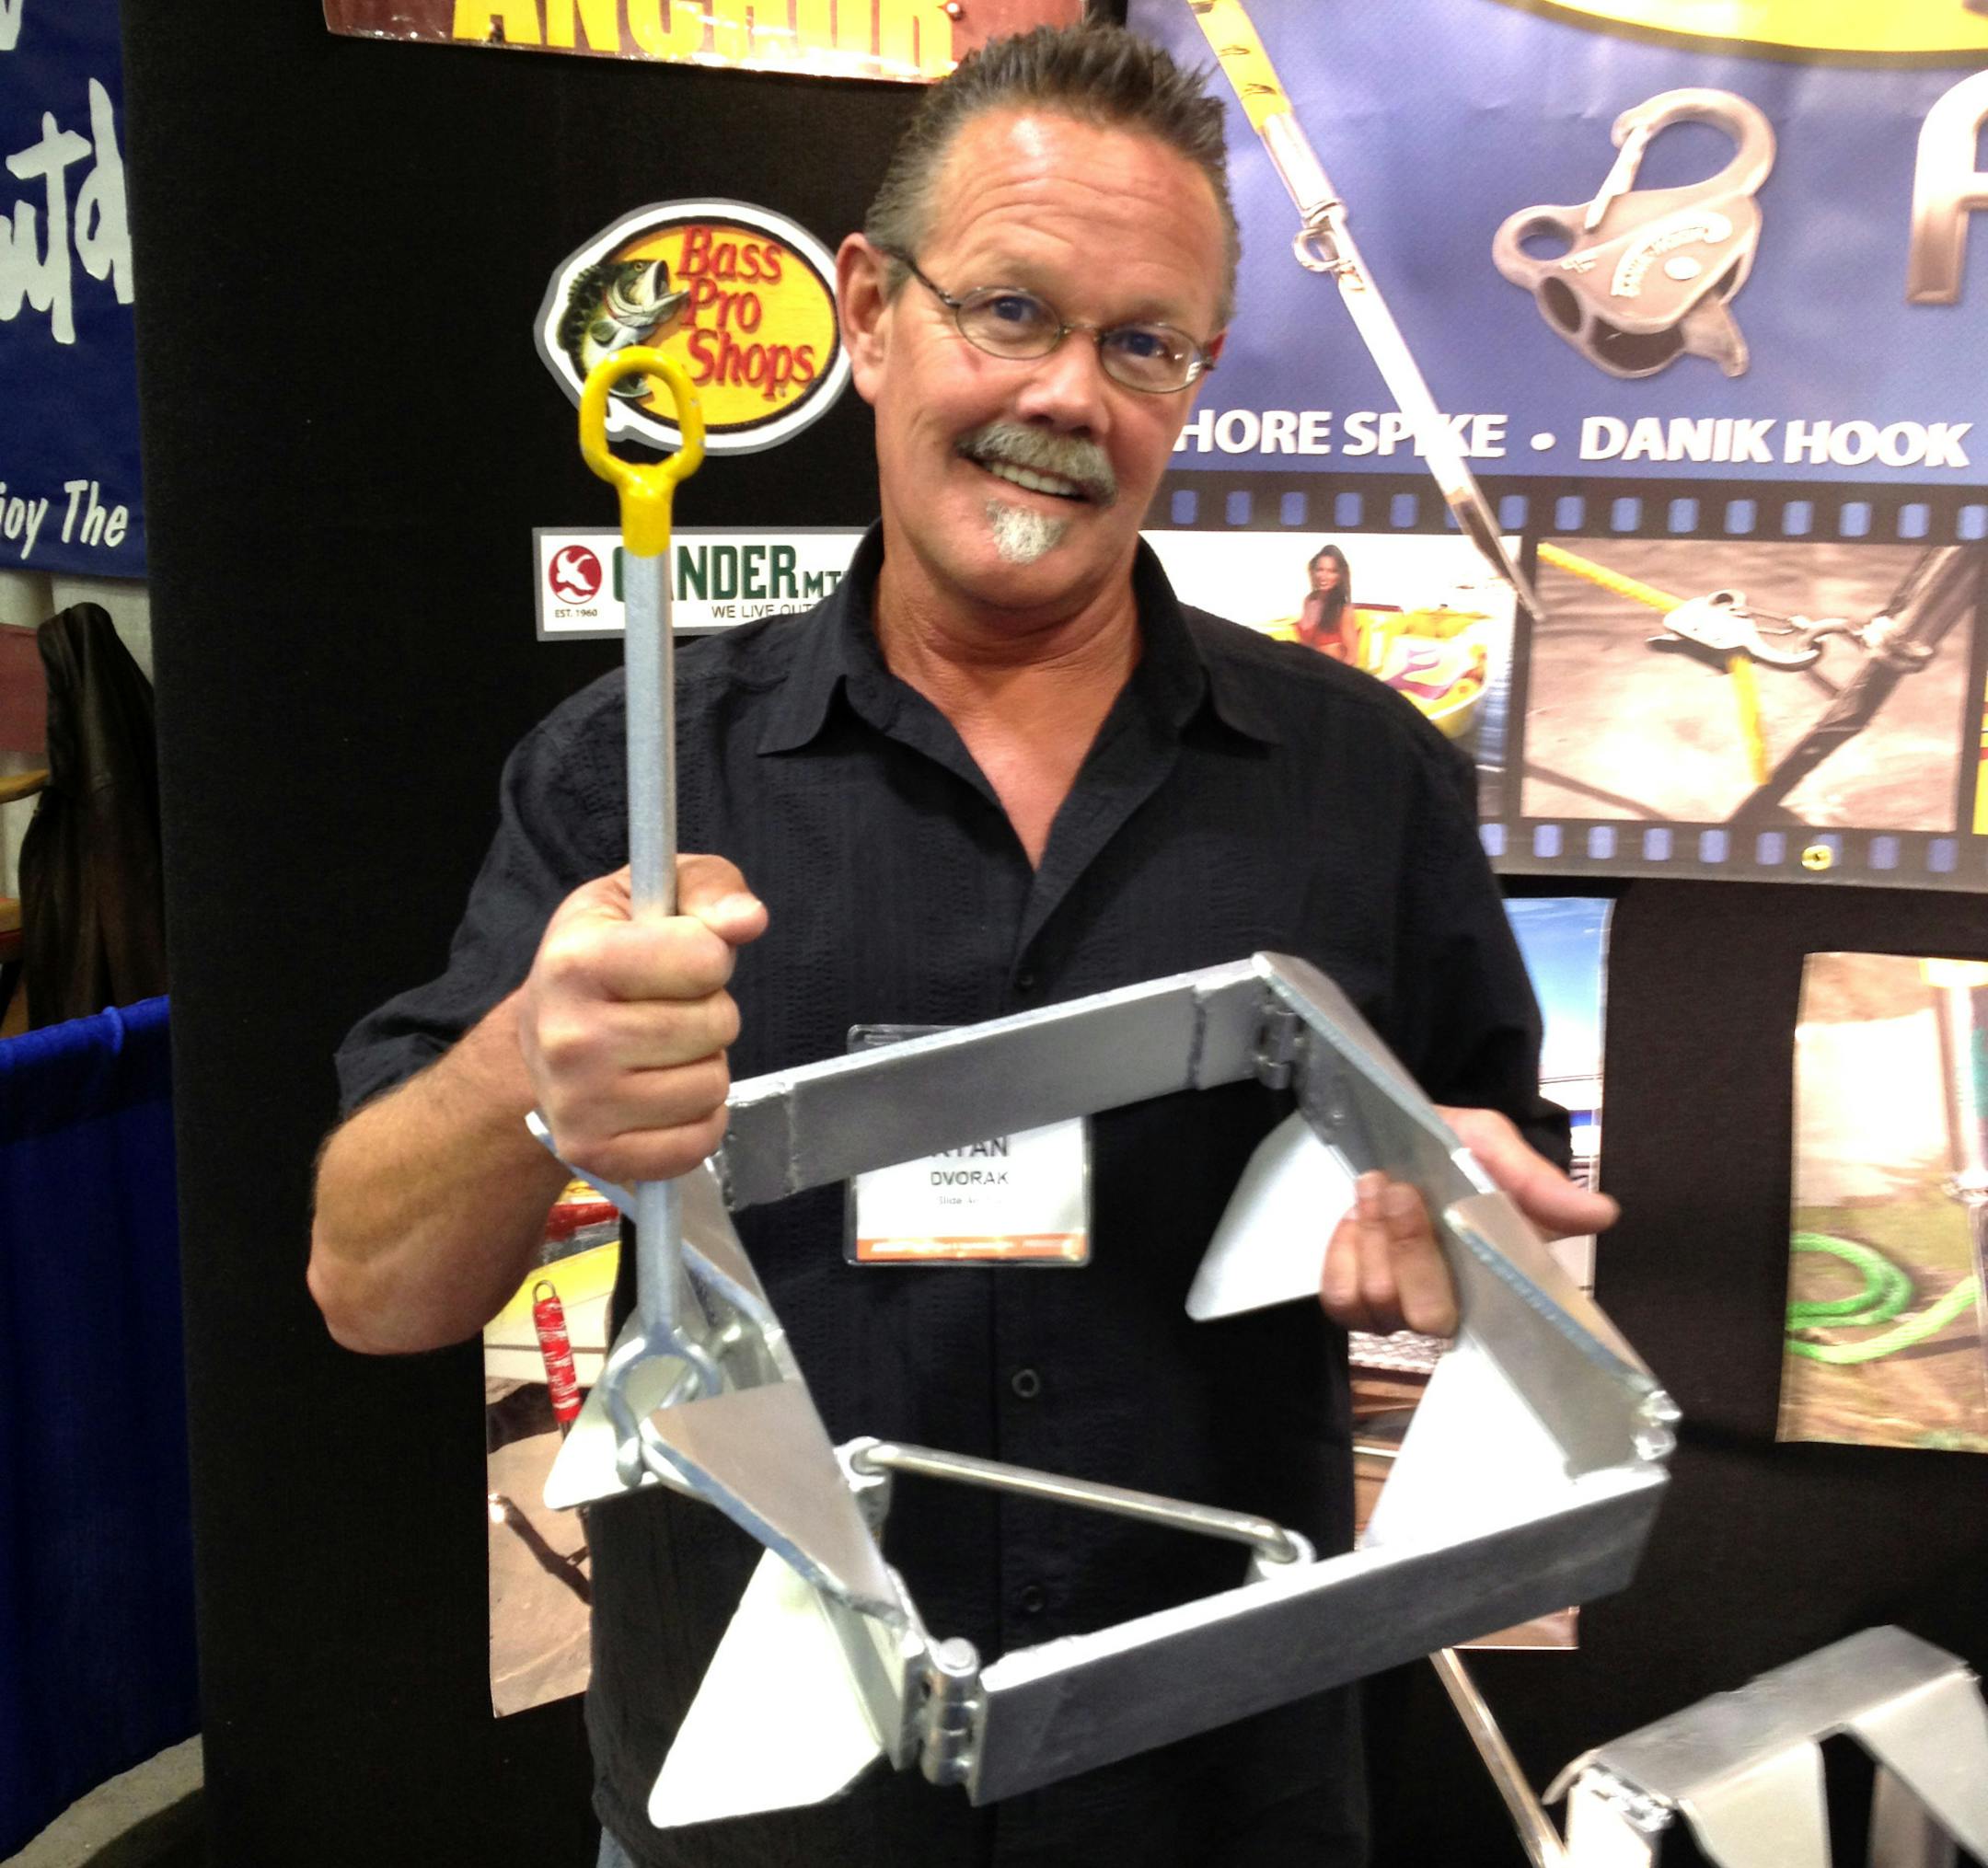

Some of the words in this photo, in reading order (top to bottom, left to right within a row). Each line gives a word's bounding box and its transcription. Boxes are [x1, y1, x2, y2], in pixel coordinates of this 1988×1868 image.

[676, 227, 782, 283] Bass
[680, 278, 762, 332] Pro
[687, 329, 815, 400] Shops
[1579, 416, 1777, 464] DANIK
[1784, 421, 1974, 467] HOOK
[61, 479, 129, 548] The
[612, 545, 799, 601] NDER
[555, 609, 573, 618] EST.
[576, 608, 598, 617] 1960
[711, 605, 735, 617] WE
[742, 605, 774, 617] LIVE
[930, 1170, 1009, 1185] DVORAK
